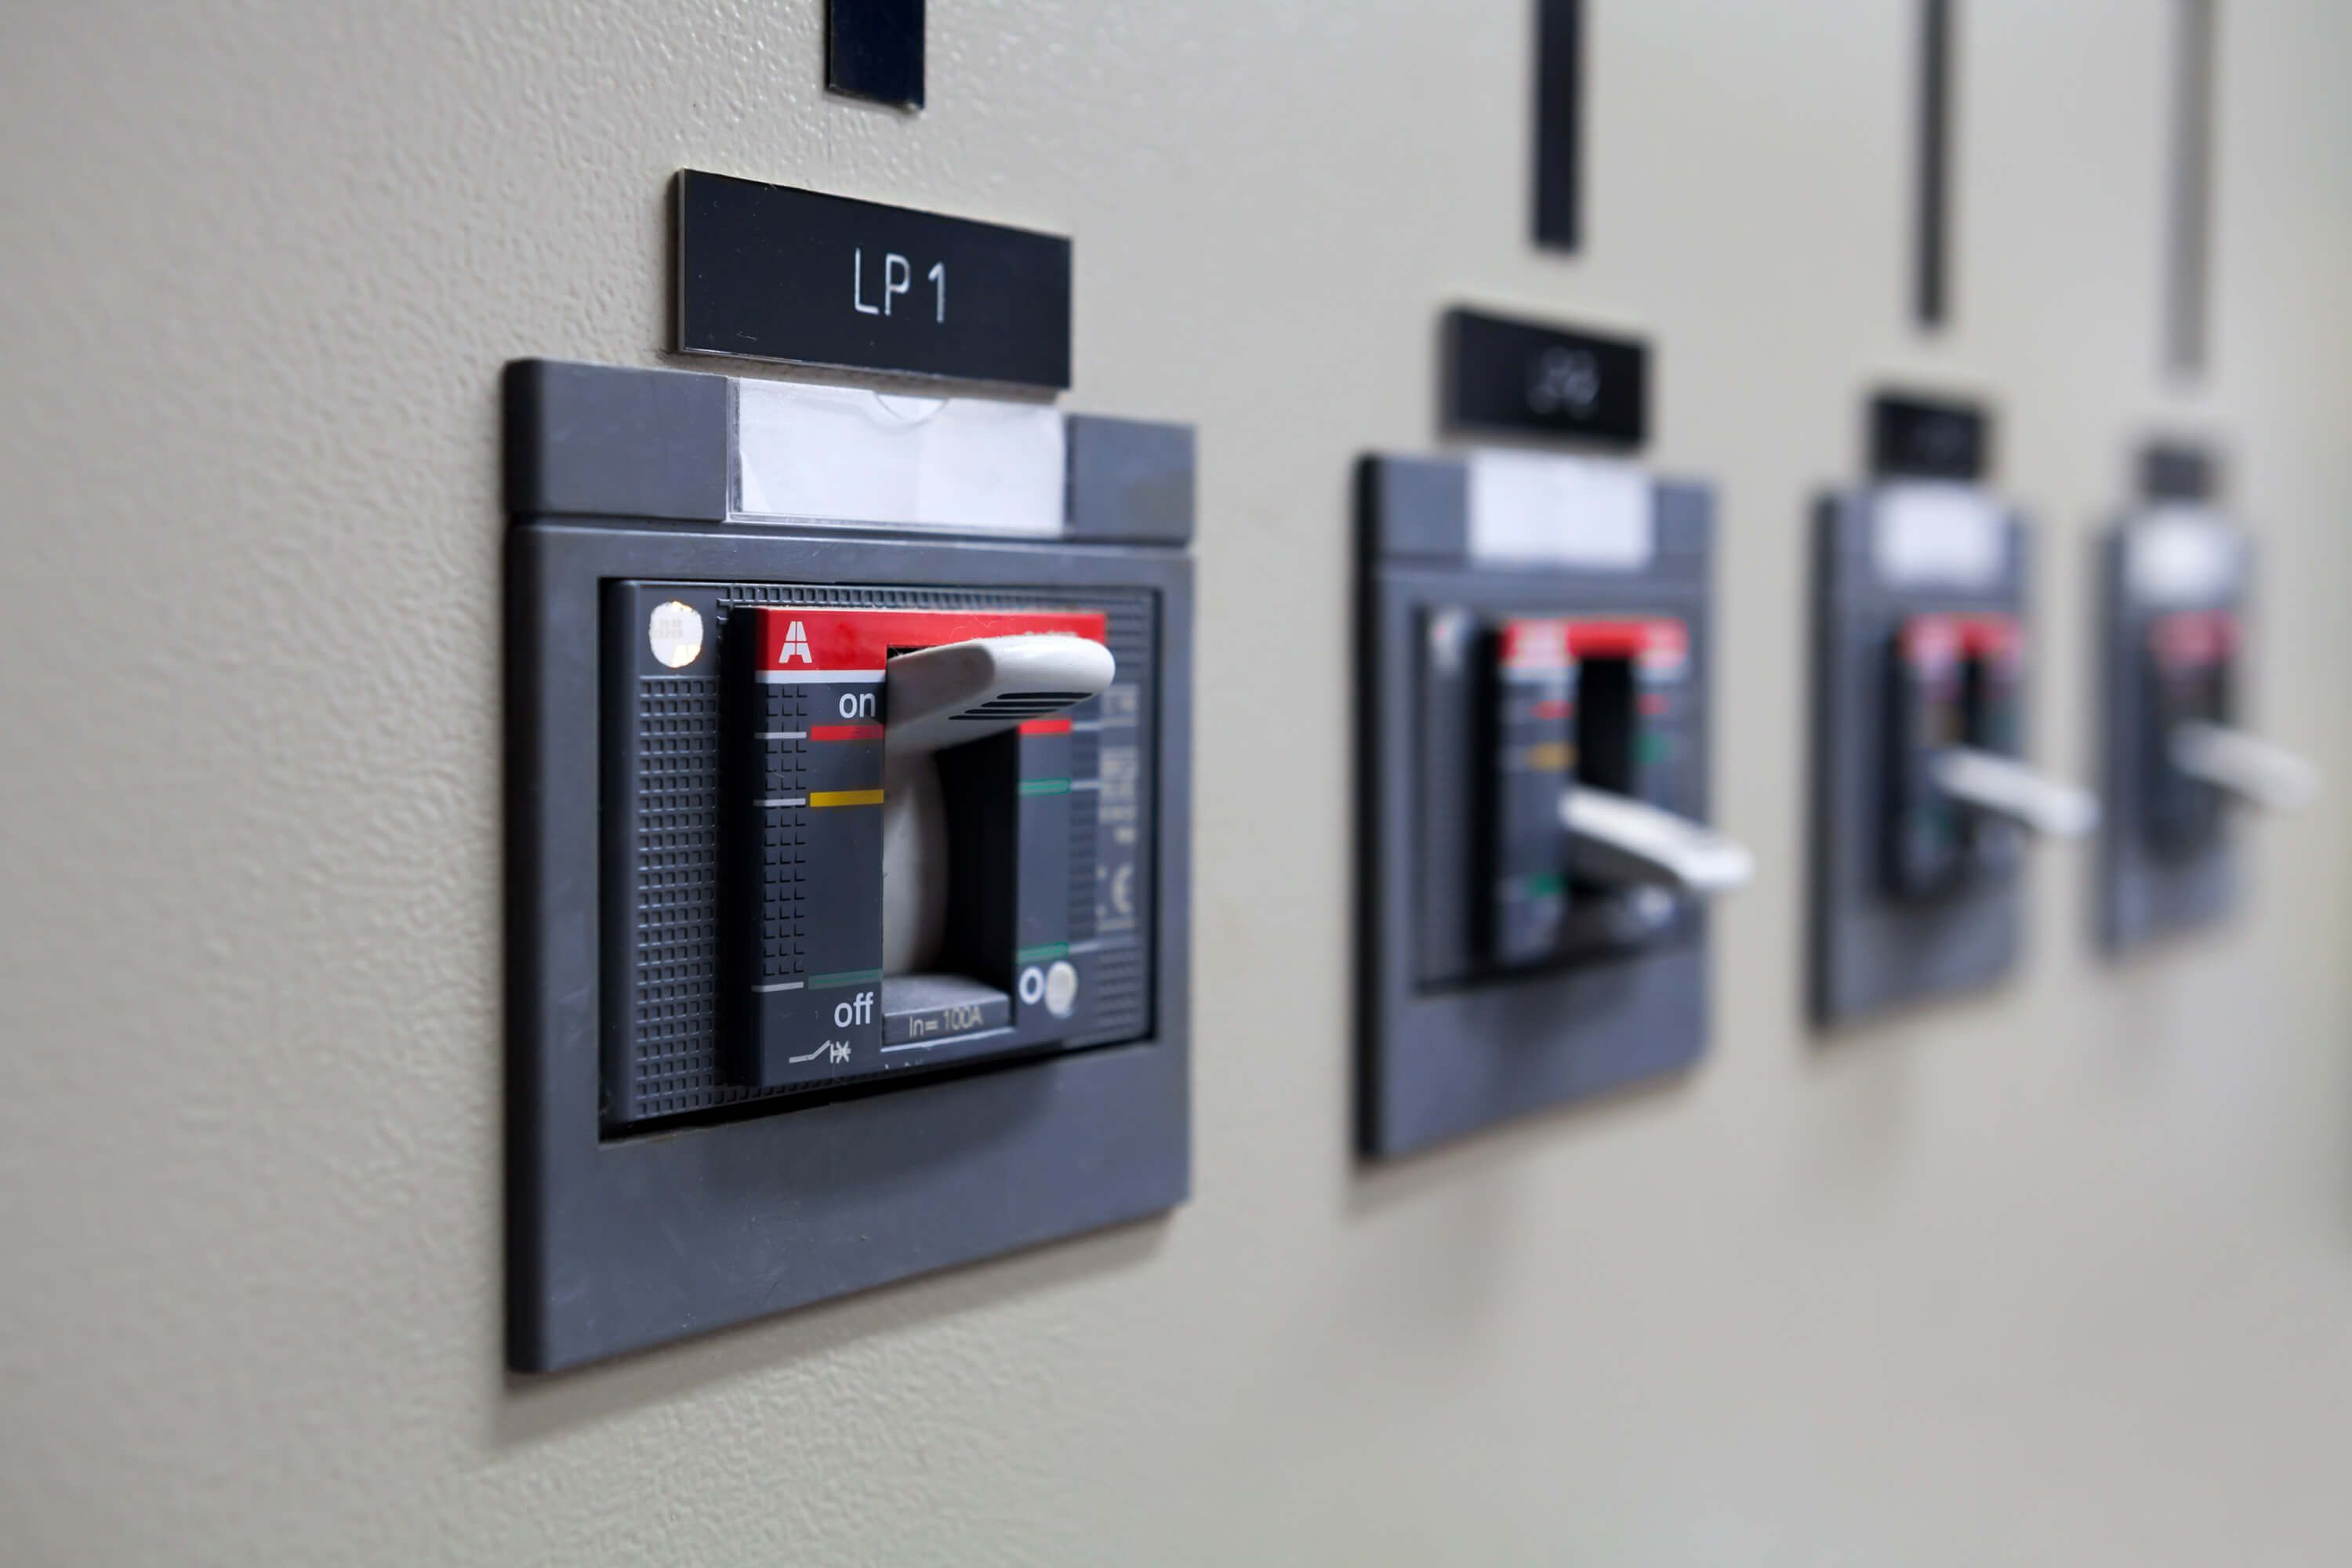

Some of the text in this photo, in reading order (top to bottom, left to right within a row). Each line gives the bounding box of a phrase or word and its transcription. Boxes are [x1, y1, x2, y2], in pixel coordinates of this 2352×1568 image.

[855, 248, 946, 323] LP 1
[838, 692, 876, 718] on
[833, 993, 874, 1028] off
[943, 1004, 983, 1030] 100A
